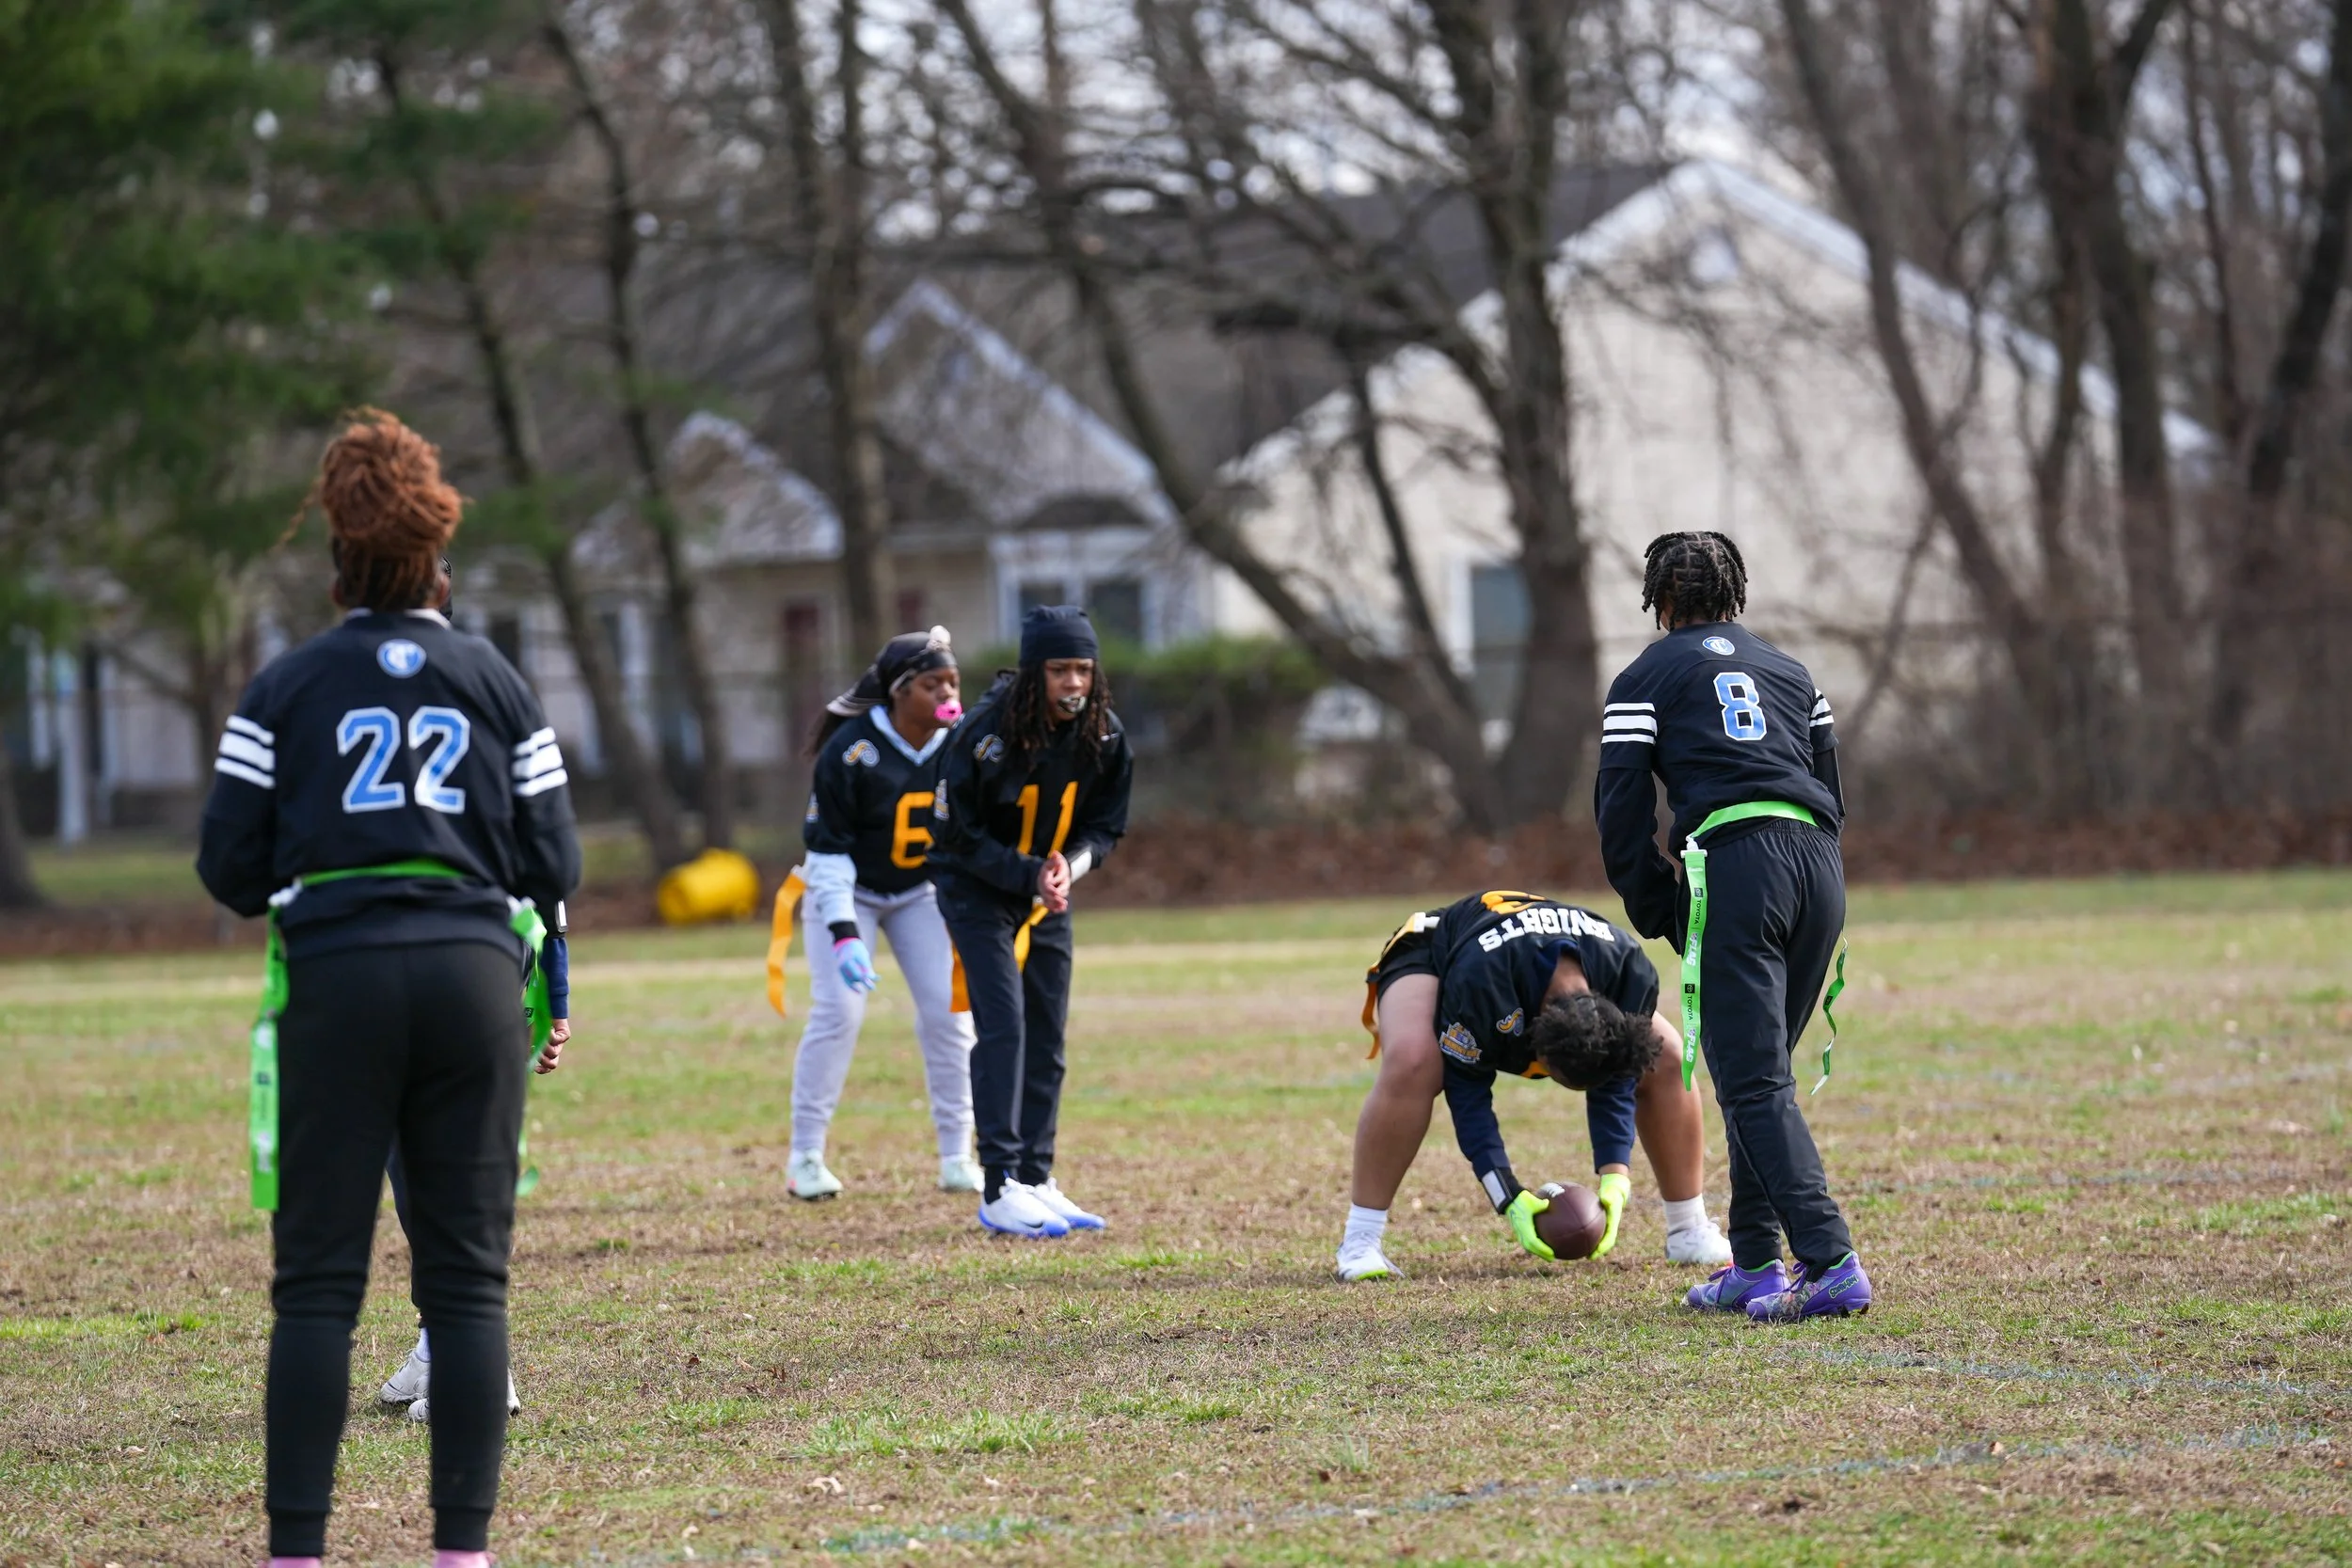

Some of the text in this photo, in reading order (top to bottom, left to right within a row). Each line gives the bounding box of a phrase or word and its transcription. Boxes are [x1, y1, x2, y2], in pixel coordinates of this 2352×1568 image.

[1713, 672, 1767, 740] 8
[336, 705, 470, 815] 22
[890, 791, 934, 868] 6
[1016, 781, 1078, 858] 11
[1478, 908, 1614, 953] KNIGHTS
[1693, 899, 1702, 925] TOYOTA
